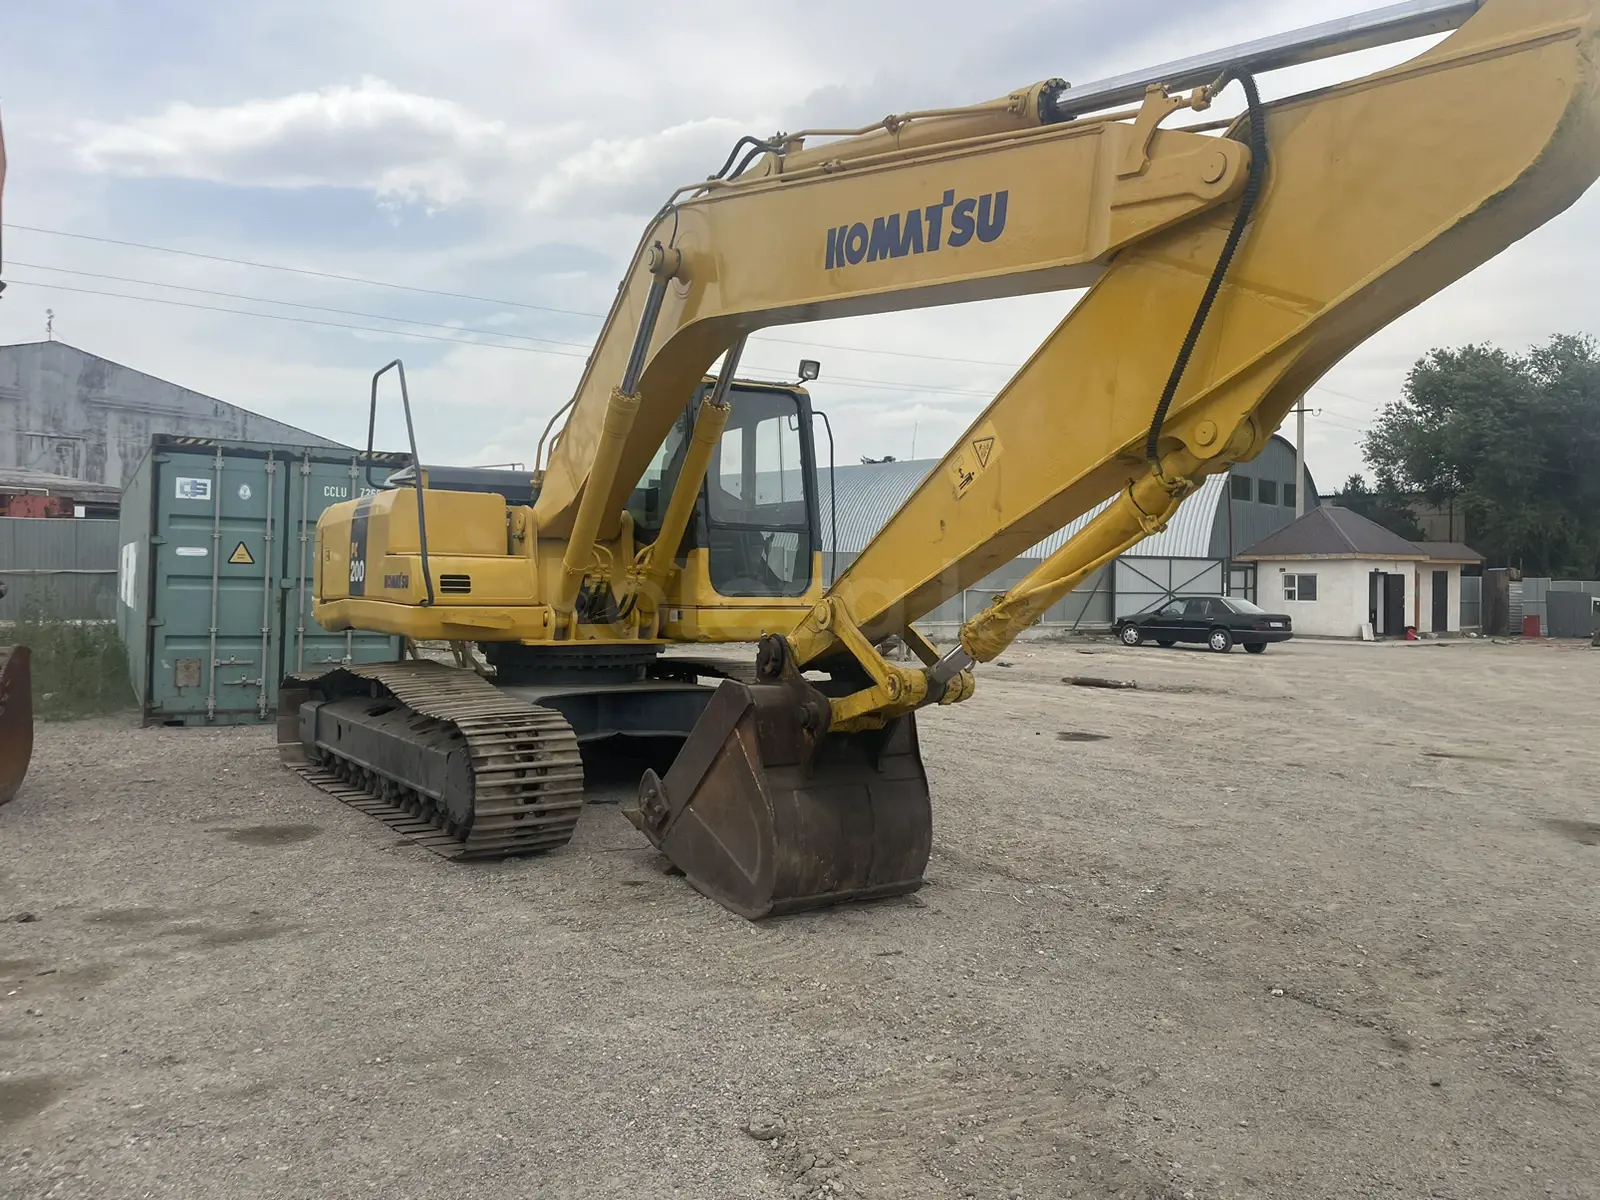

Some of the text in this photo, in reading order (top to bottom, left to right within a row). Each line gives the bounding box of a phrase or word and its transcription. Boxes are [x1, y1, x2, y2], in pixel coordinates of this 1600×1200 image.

[824, 189, 1009, 270] KOMATSU
[324, 485, 347, 498] CCLU
[350, 560, 365, 582] 200
